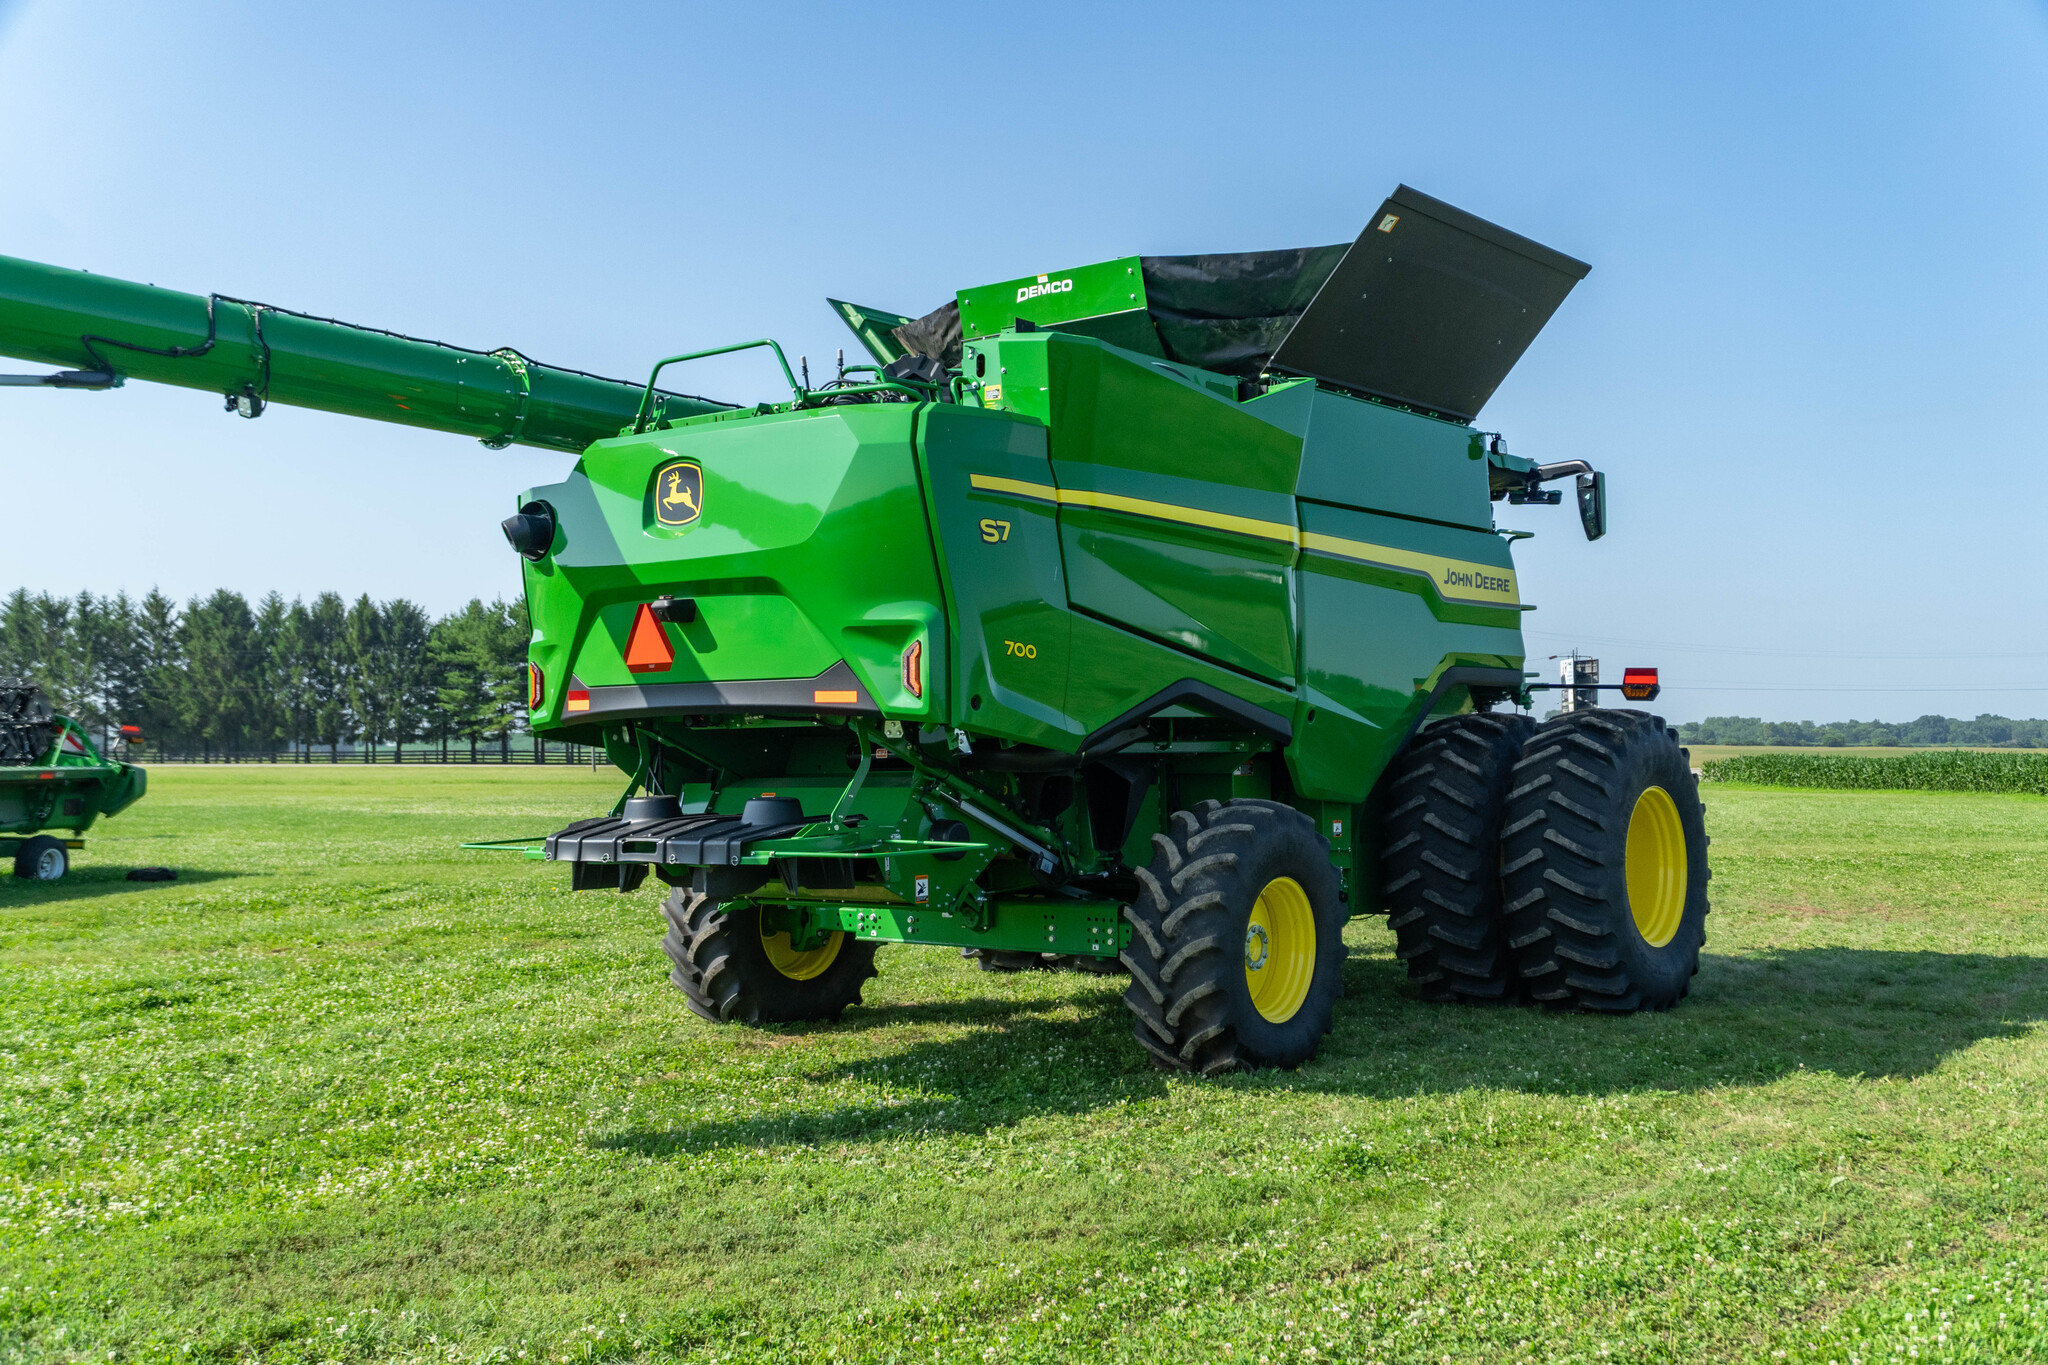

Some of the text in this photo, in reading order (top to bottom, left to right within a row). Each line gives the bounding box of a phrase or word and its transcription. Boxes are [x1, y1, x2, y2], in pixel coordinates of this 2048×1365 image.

[1016, 279, 1073, 303] DEMCO
[979, 518, 1011, 545] S7
[1444, 568, 1510, 592] JOHN DEERE
[1004, 639, 1037, 660] 700
